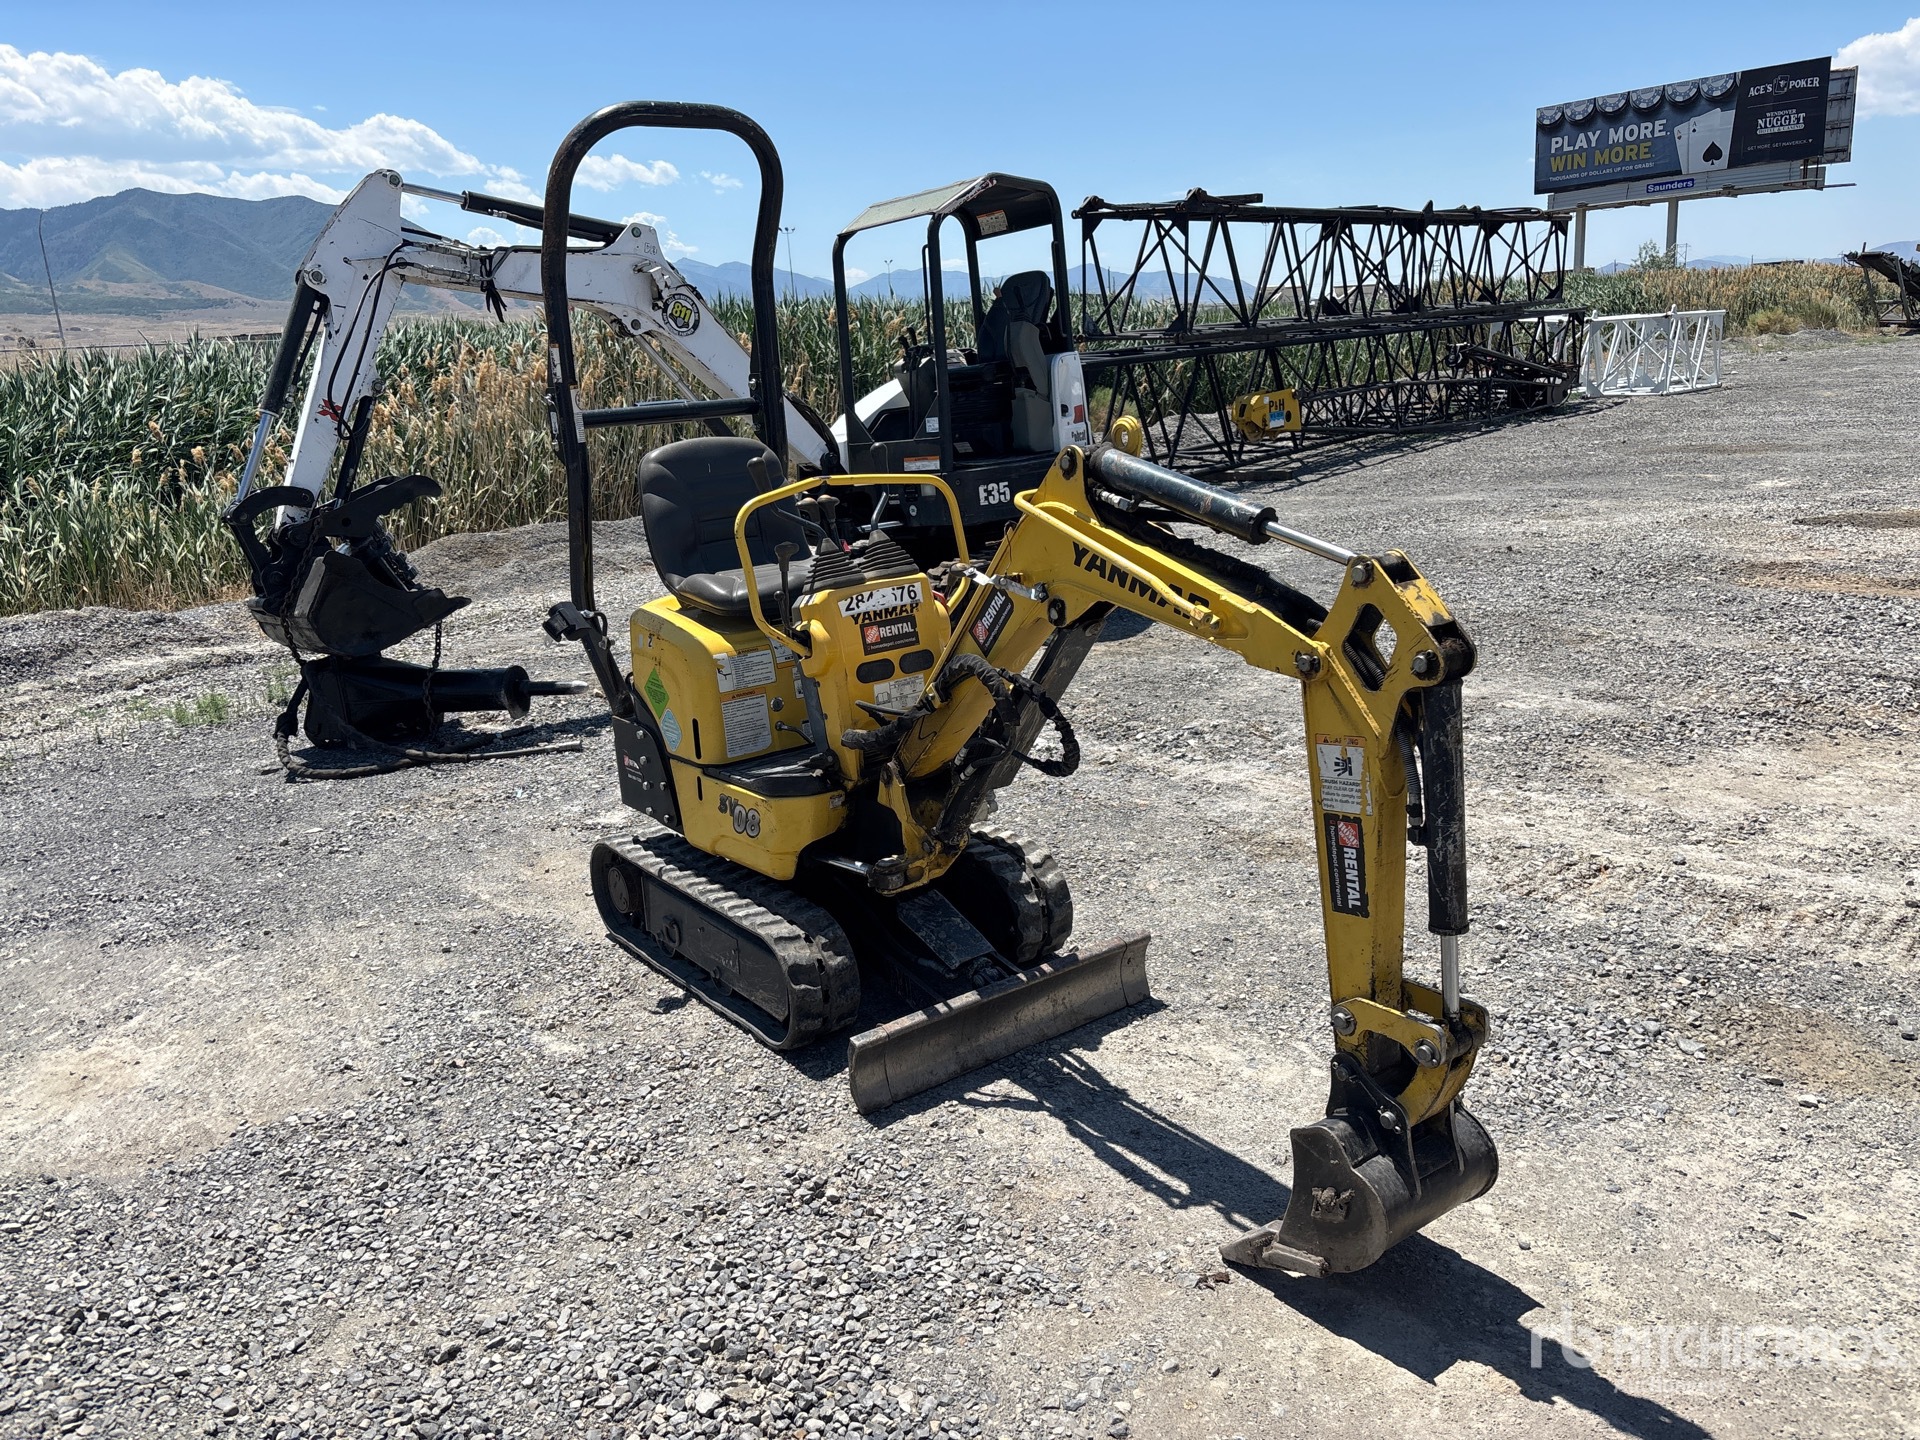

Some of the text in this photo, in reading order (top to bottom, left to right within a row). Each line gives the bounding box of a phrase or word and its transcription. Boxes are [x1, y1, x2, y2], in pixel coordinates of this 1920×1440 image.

[1748, 76, 1820, 97] ACE'S POKER
[1757, 112, 1806, 129] NUGGET
[1766, 108, 1797, 118] WENDOVER
[1550, 119, 1671, 154] PLAY MORE.
[1550, 142, 1656, 173] WIN MORE.
[1549, 173, 1580, 182] THOUSANDS
[1588, 167, 1613, 177] DOLLARS
[1647, 180, 1693, 193] Saunders
[672, 301, 693, 323] 811
[1268, 398, 1285, 412] P&H
[978, 481, 1011, 506] E35
[1072, 541, 1210, 620] YANMAR
[844, 584, 918, 613] 2876
[981, 591, 1006, 630] RENTAL
[879, 621, 915, 639] RENTAL
[1329, 825, 1343, 907] homedepot.com/rental
[1343, 847, 1362, 909] RENTAL
